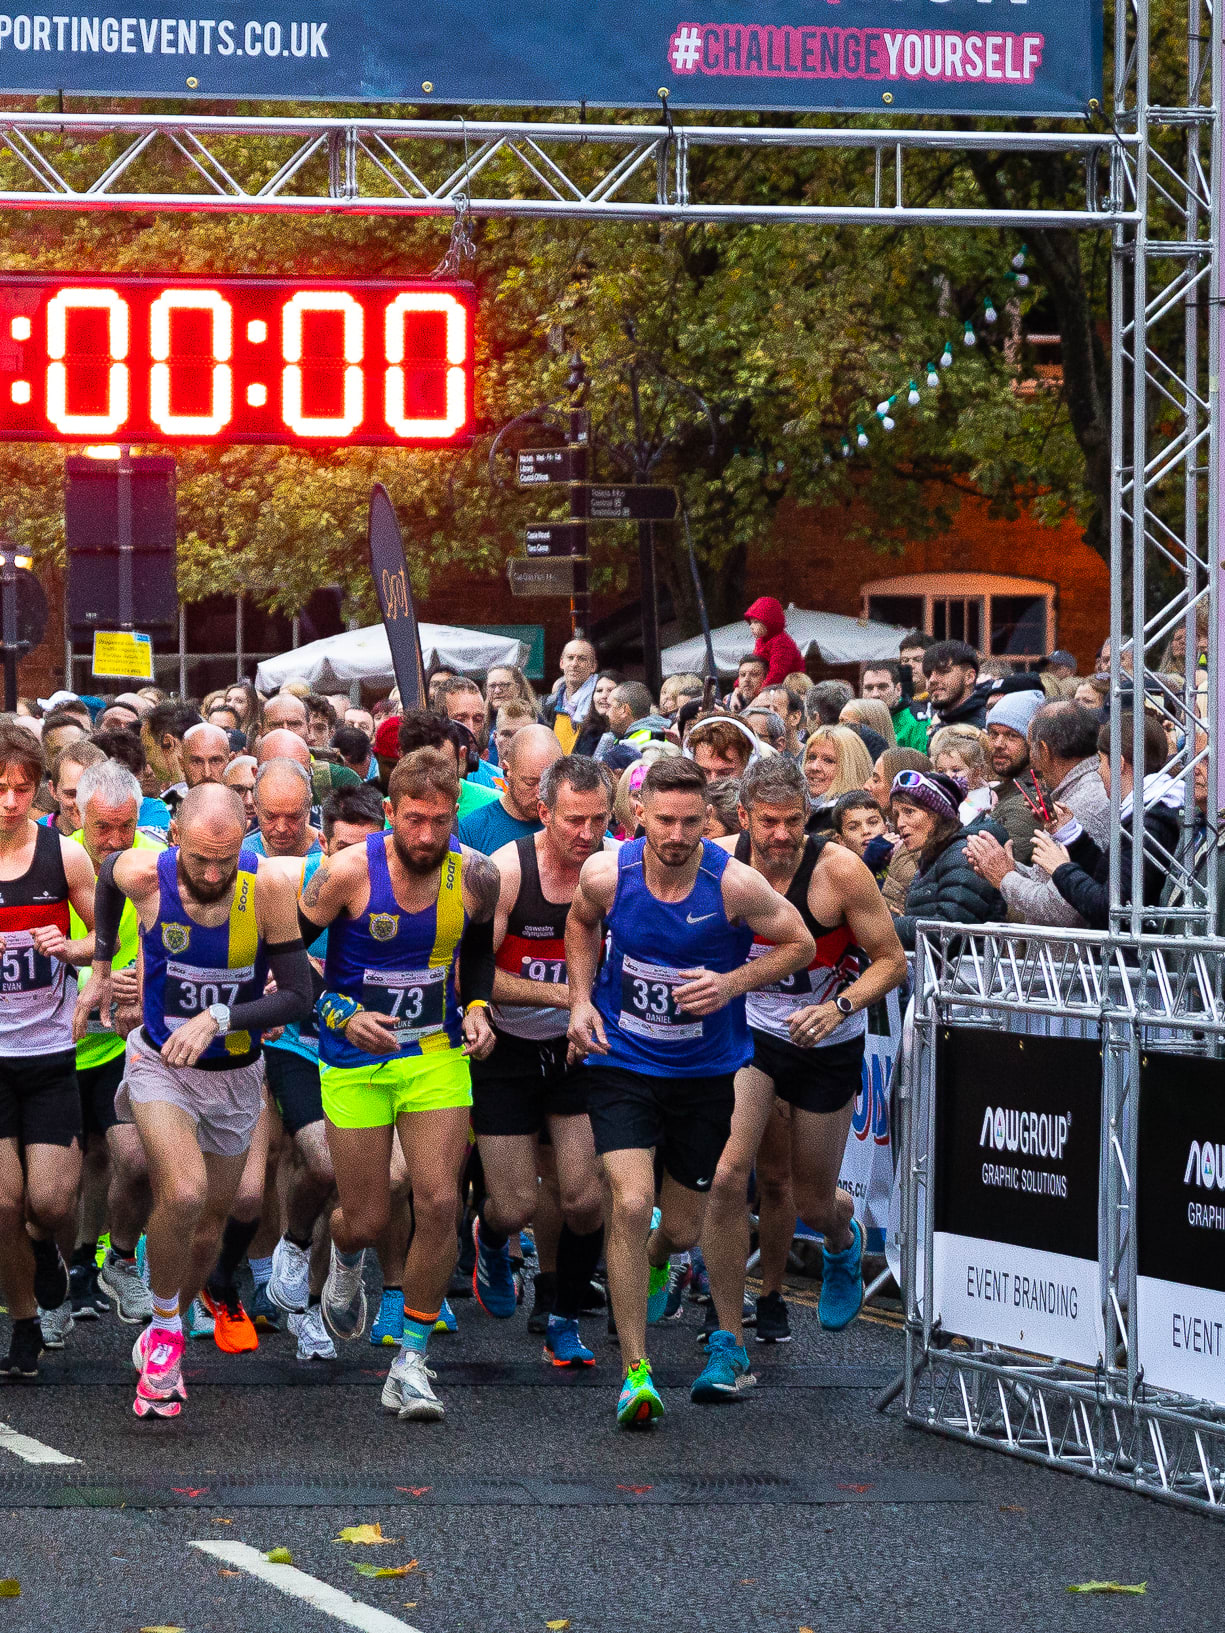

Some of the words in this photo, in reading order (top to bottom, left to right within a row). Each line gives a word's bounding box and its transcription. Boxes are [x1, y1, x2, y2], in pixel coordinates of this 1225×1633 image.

[672, 26, 1041, 79] #CHALLENGEYOURSELF
[446, 858, 457, 890] soar
[237, 879, 249, 913] soar
[2, 982, 22, 992] EVAN
[529, 961, 568, 984] 91
[180, 981, 239, 1010] 307
[387, 987, 424, 1019] 73
[646, 1012, 672, 1024] DANIEL
[981, 1162, 1019, 1189] GRAPHIC
[1021, 1168, 1067, 1198] SOLUTIONS
[966, 1265, 1010, 1303] EVENT
[1013, 1274, 1079, 1320] BRANDING
[1172, 1313, 1223, 1357] EVENT
